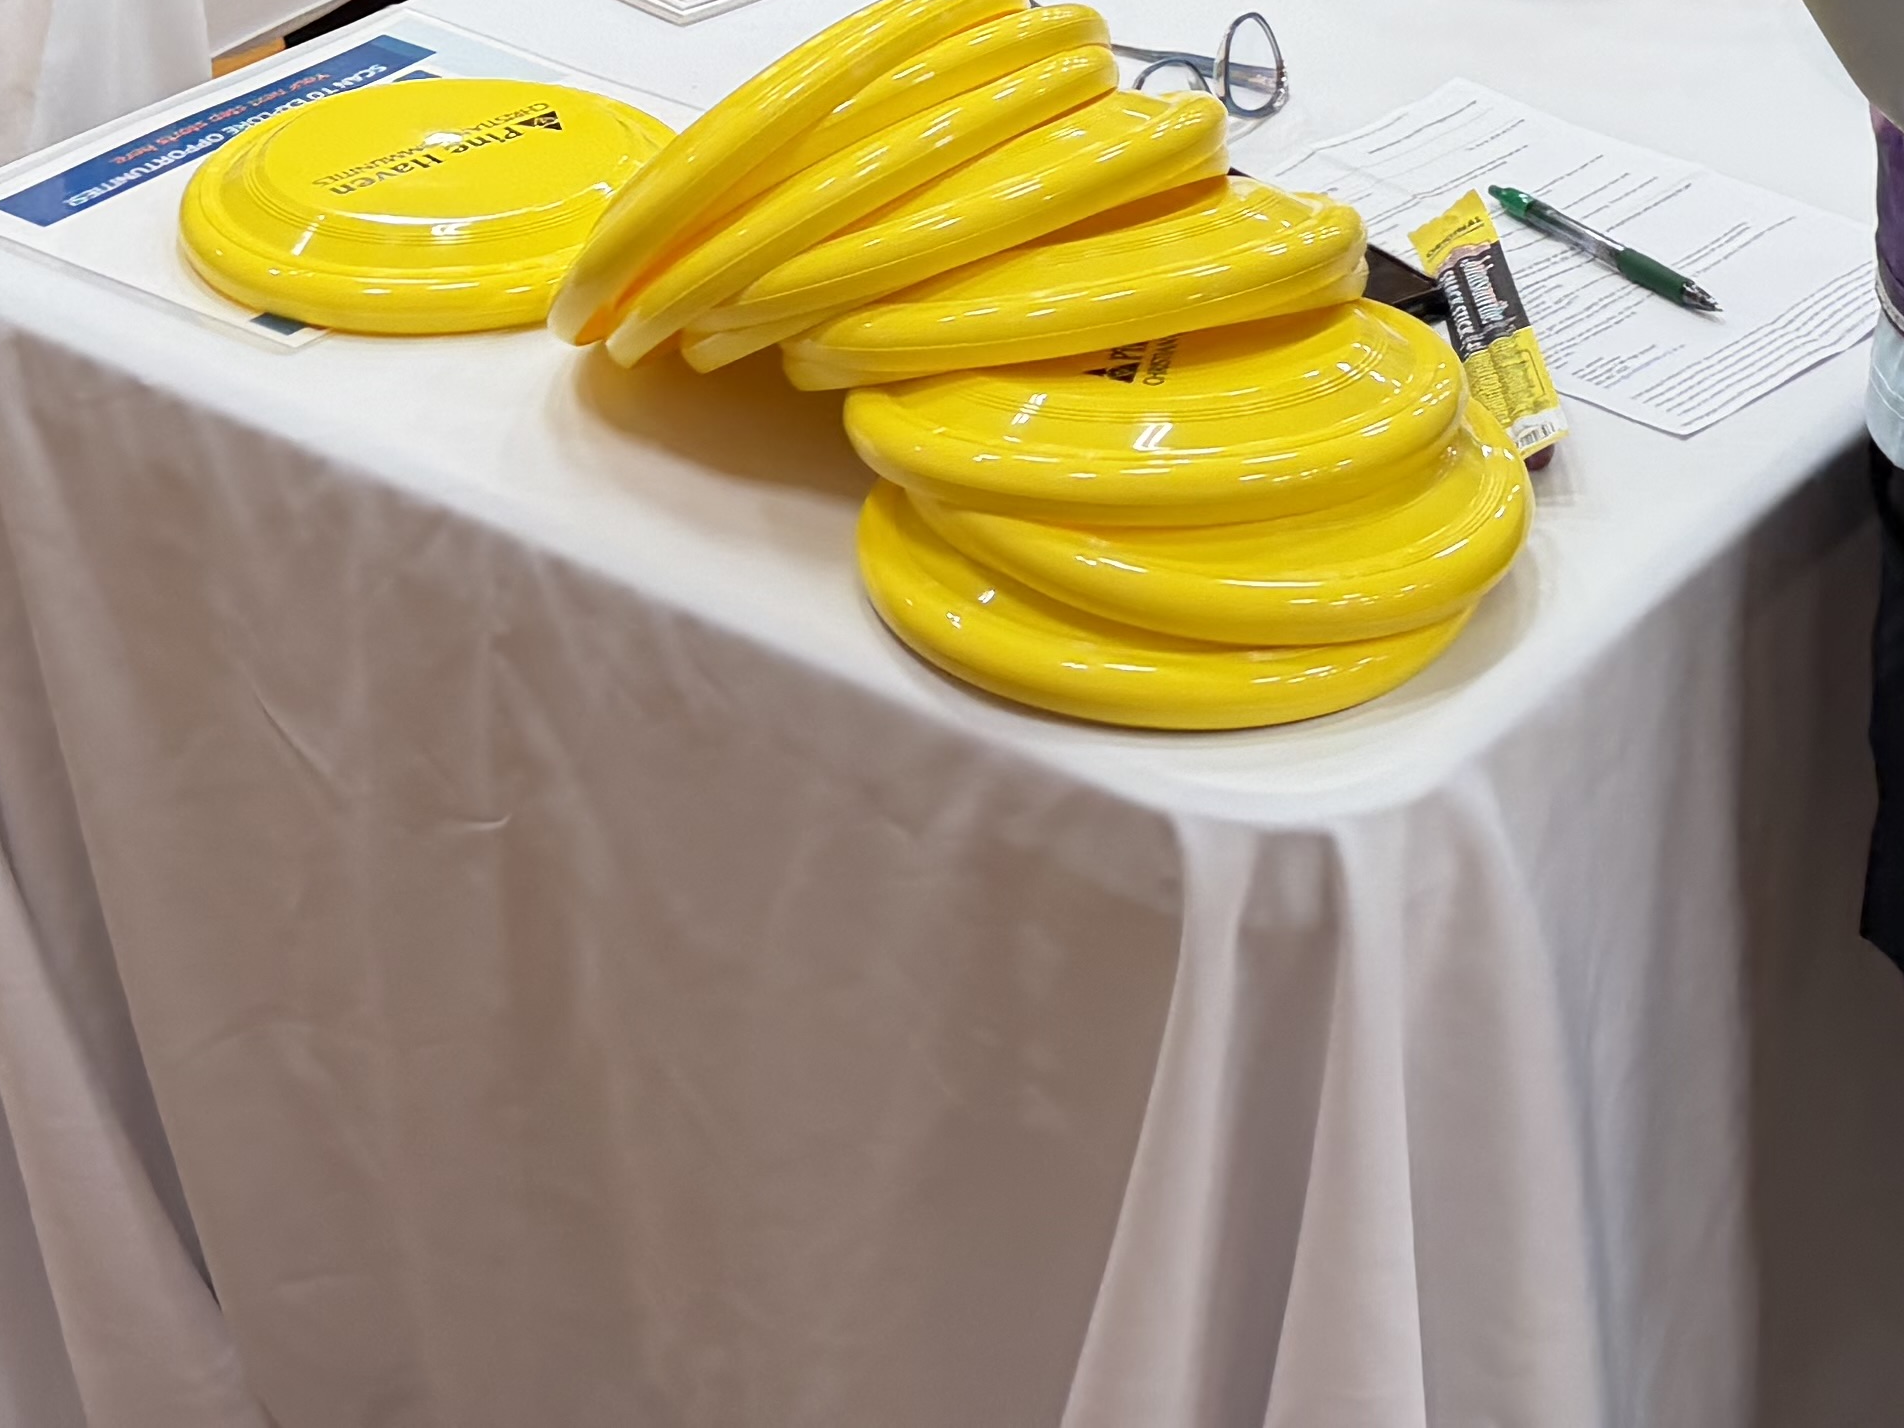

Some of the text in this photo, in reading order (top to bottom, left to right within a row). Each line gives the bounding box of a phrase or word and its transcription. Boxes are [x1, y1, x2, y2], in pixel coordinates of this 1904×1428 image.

[334, 64, 387, 89] SCAN
[306, 86, 338, 101] TO
[330, 126, 525, 195] Pine Haven
